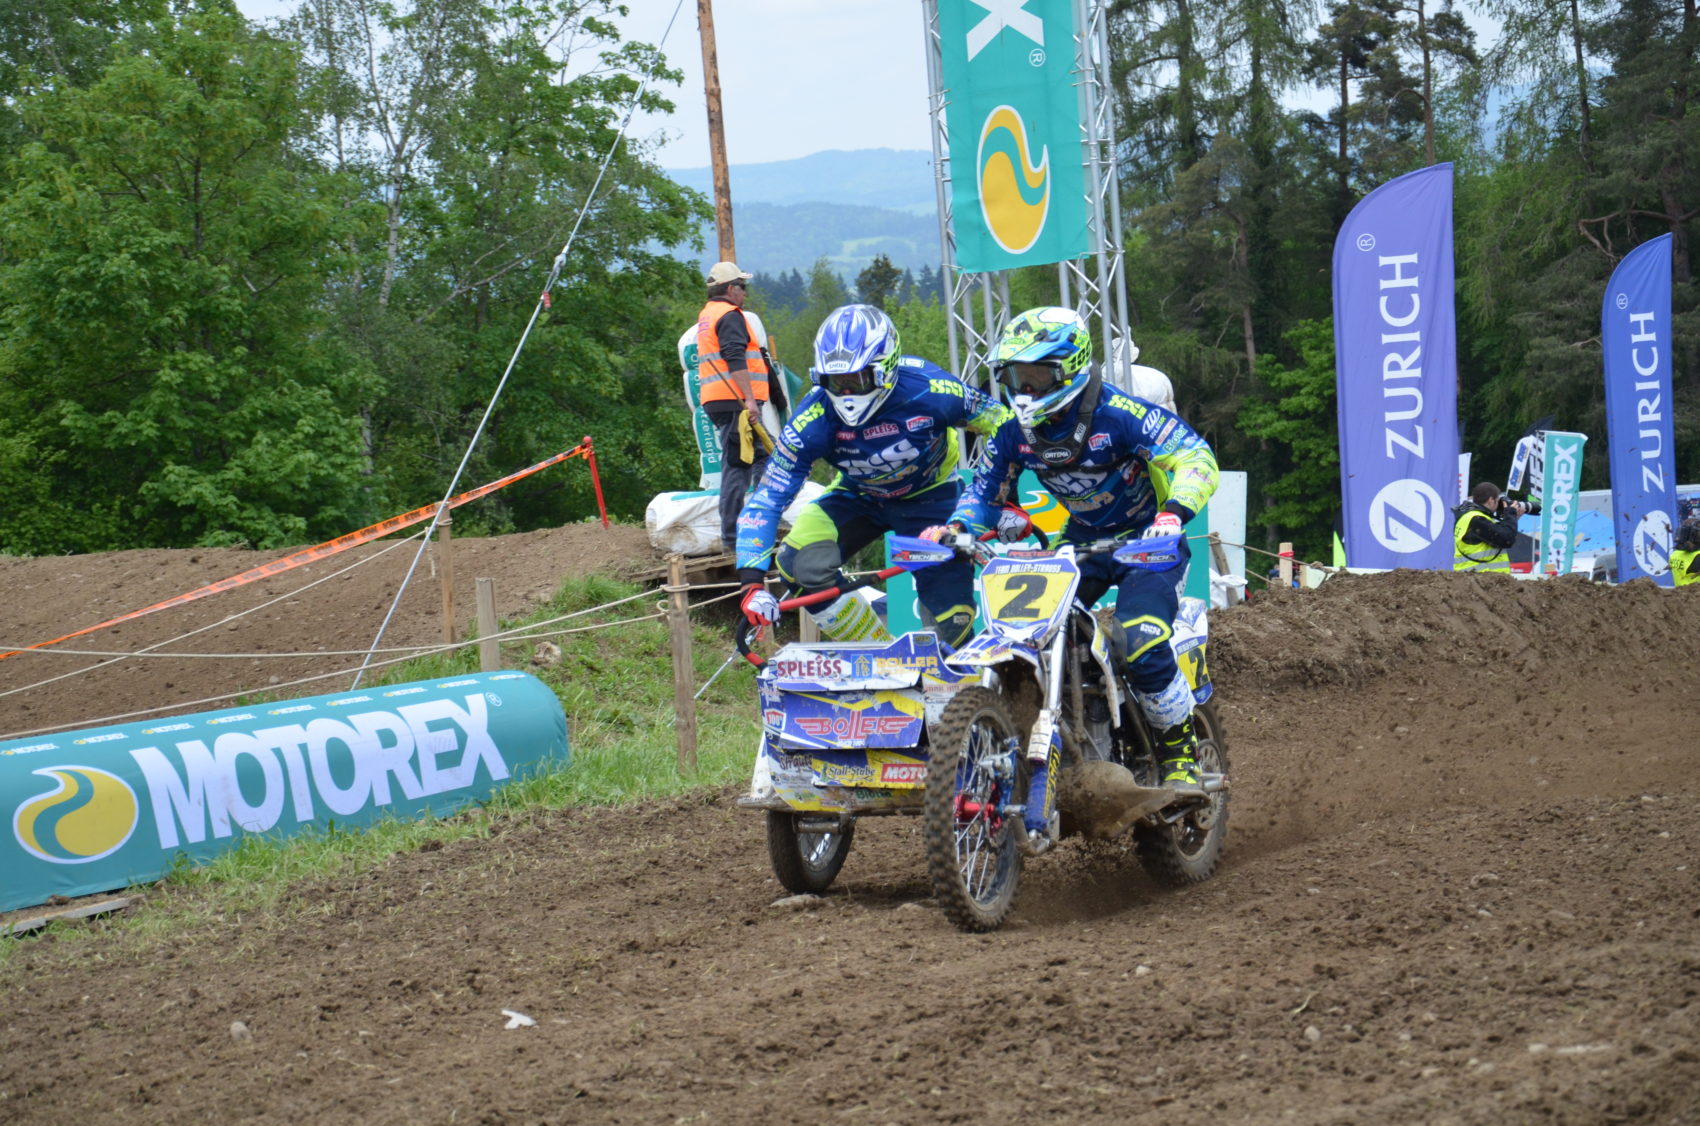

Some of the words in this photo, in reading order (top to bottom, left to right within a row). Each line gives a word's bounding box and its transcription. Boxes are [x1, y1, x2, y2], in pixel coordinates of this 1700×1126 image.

[1379, 252, 1425, 460] ZURICH
[1630, 311, 1666, 494] ZURICH
[998, 575, 1048, 619] 2
[777, 655, 843, 678] SPLEISS
[810, 710, 896, 740] BOLLER
[129, 693, 509, 850] MOTOREX
[884, 765, 931, 779] MOTU
